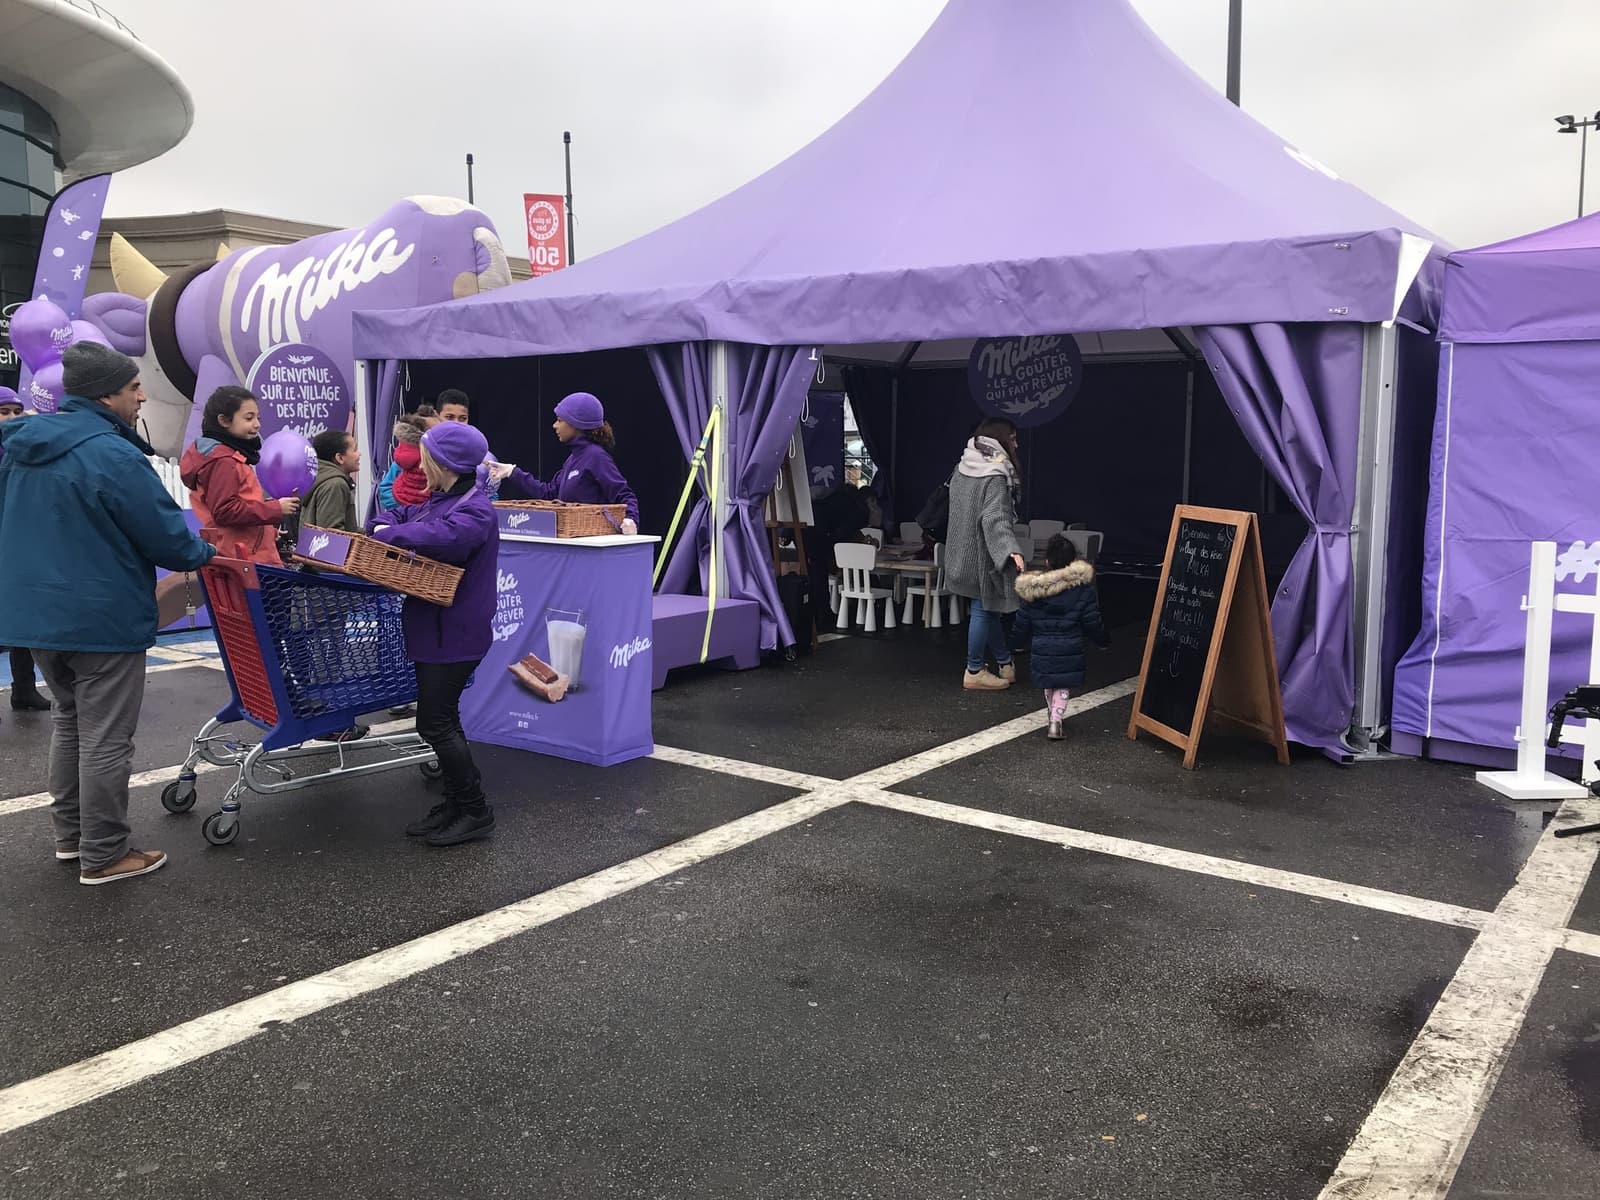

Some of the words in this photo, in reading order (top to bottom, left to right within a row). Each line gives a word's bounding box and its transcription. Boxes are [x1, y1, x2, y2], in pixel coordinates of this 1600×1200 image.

[240, 227, 416, 353] Milka
[270, 366, 330, 383] BIENVENUE
[994, 377, 1008, 389] LE
[1015, 352, 1069, 380] GOÛTER
[986, 388, 1006, 401] QUI
[1008, 381, 1030, 396] FAIT
[1031, 365, 1074, 390] RÊVER
[260, 384, 283, 400] SUR
[285, 386, 296, 401] LE
[299, 385, 341, 401] VILLAGE
[276, 403, 296, 418] DES
[297, 401, 329, 418] RÊVES
[507, 512, 531, 529] Milka
[497, 594, 522, 611] ÛTER
[498, 608, 525, 624] RÊVER
[610, 636, 652, 668] Milka
